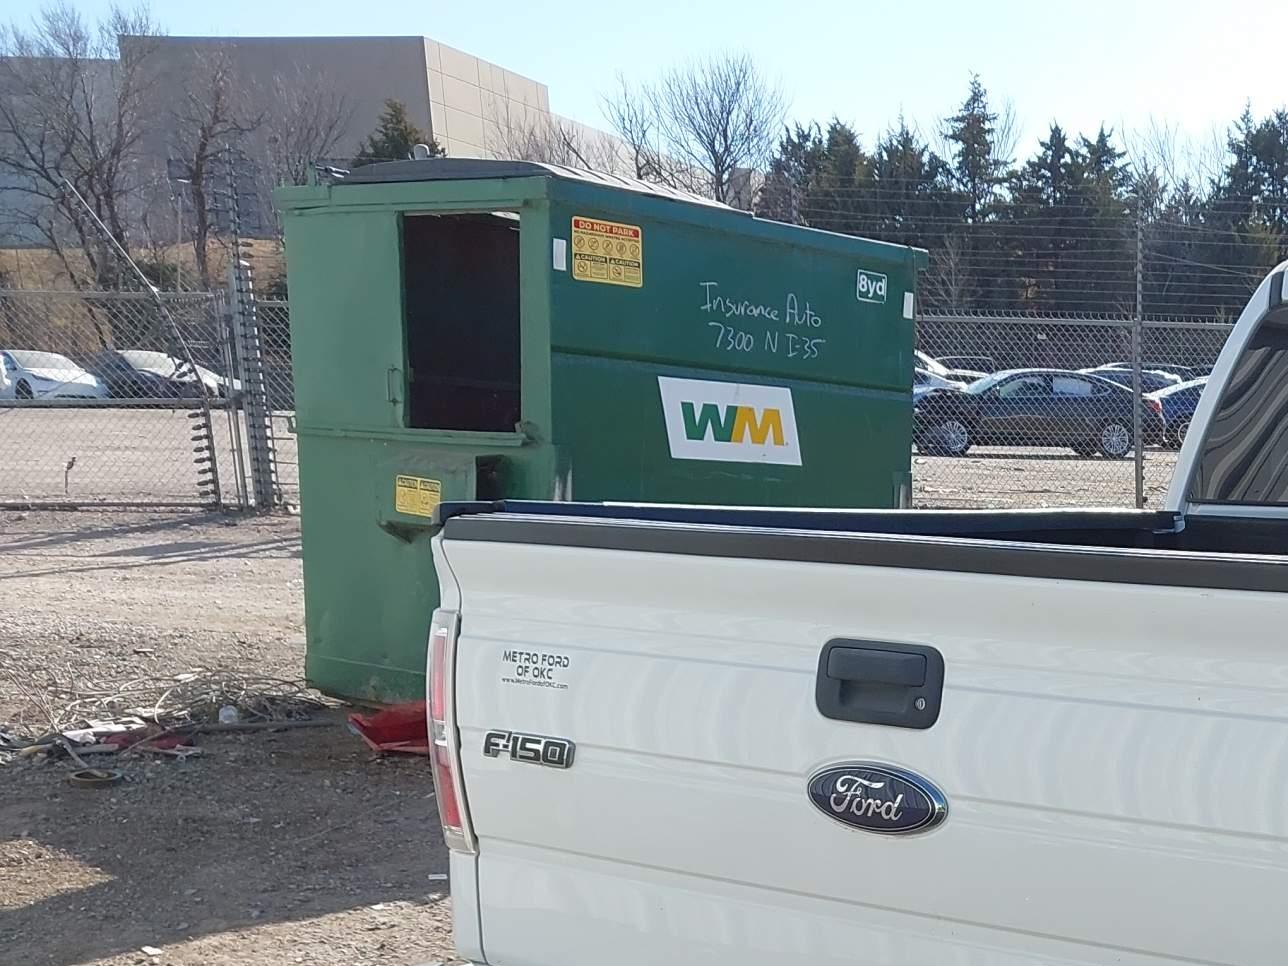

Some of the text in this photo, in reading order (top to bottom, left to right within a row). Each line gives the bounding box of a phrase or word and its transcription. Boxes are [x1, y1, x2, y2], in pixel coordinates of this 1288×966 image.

[579, 220, 592, 230] DO
[593, 223, 611, 233] NOT
[612, 226, 634, 237] PARK
[580, 254, 606, 262] CAUTION
[615, 258, 639, 267] CAUTION
[859, 274, 885, 298] 8yd
[700, 281, 822, 328] Insurance Auto
[708, 321, 827, 359] 7300 N I-35
[680, 401, 785, 446] WM
[502, 650, 570, 668] METRO FORD
[516, 665, 554, 680] OF OKC
[483, 731, 570, 768] F-150
[829, 774, 904, 821] Ford
